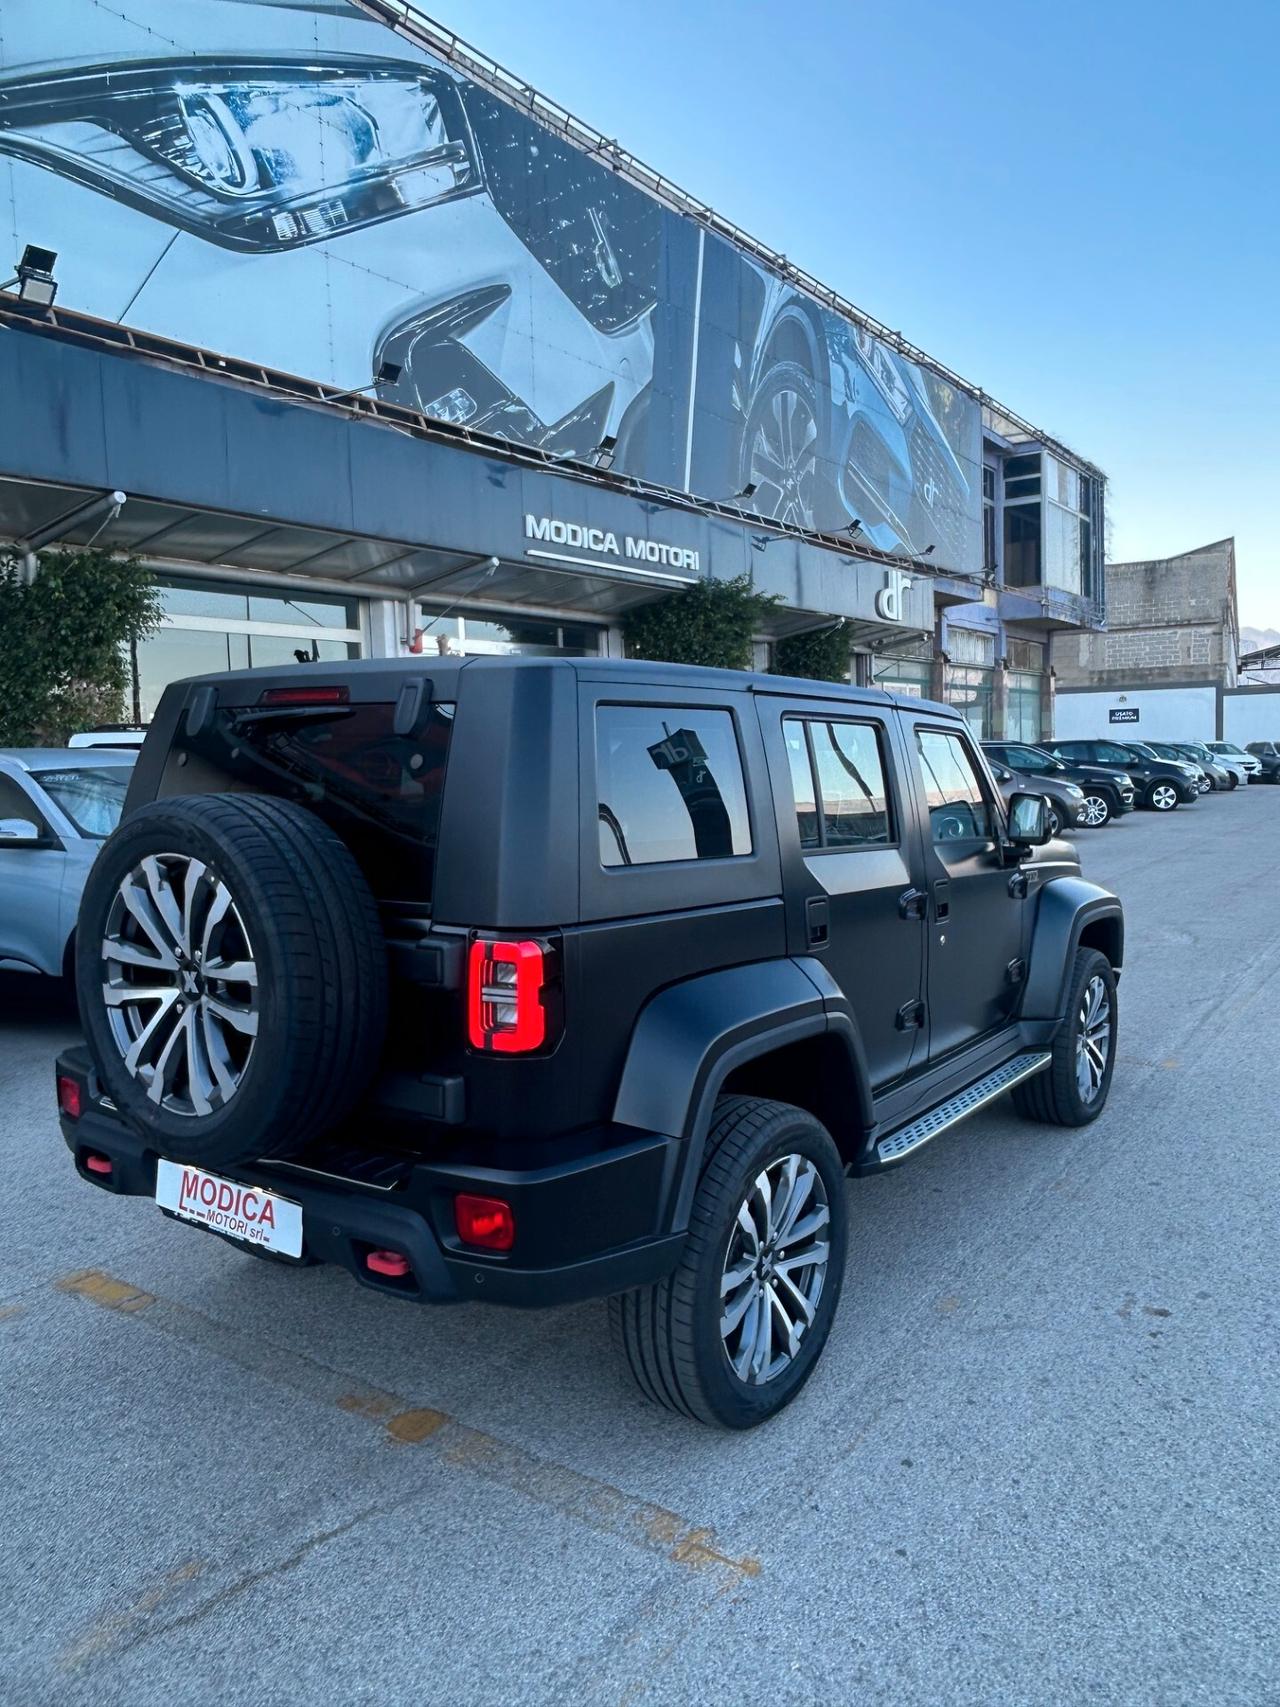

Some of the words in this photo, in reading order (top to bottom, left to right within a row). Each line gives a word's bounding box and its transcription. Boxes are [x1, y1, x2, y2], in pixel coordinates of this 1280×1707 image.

[525, 514, 620, 555] MODICA
[625, 536, 699, 570] MOTORI
[878, 569, 912, 621] dr
[179, 1170, 275, 1229] MODICA
[206, 1209, 248, 1235] MOTORI
[250, 1228, 264, 1241] srl
